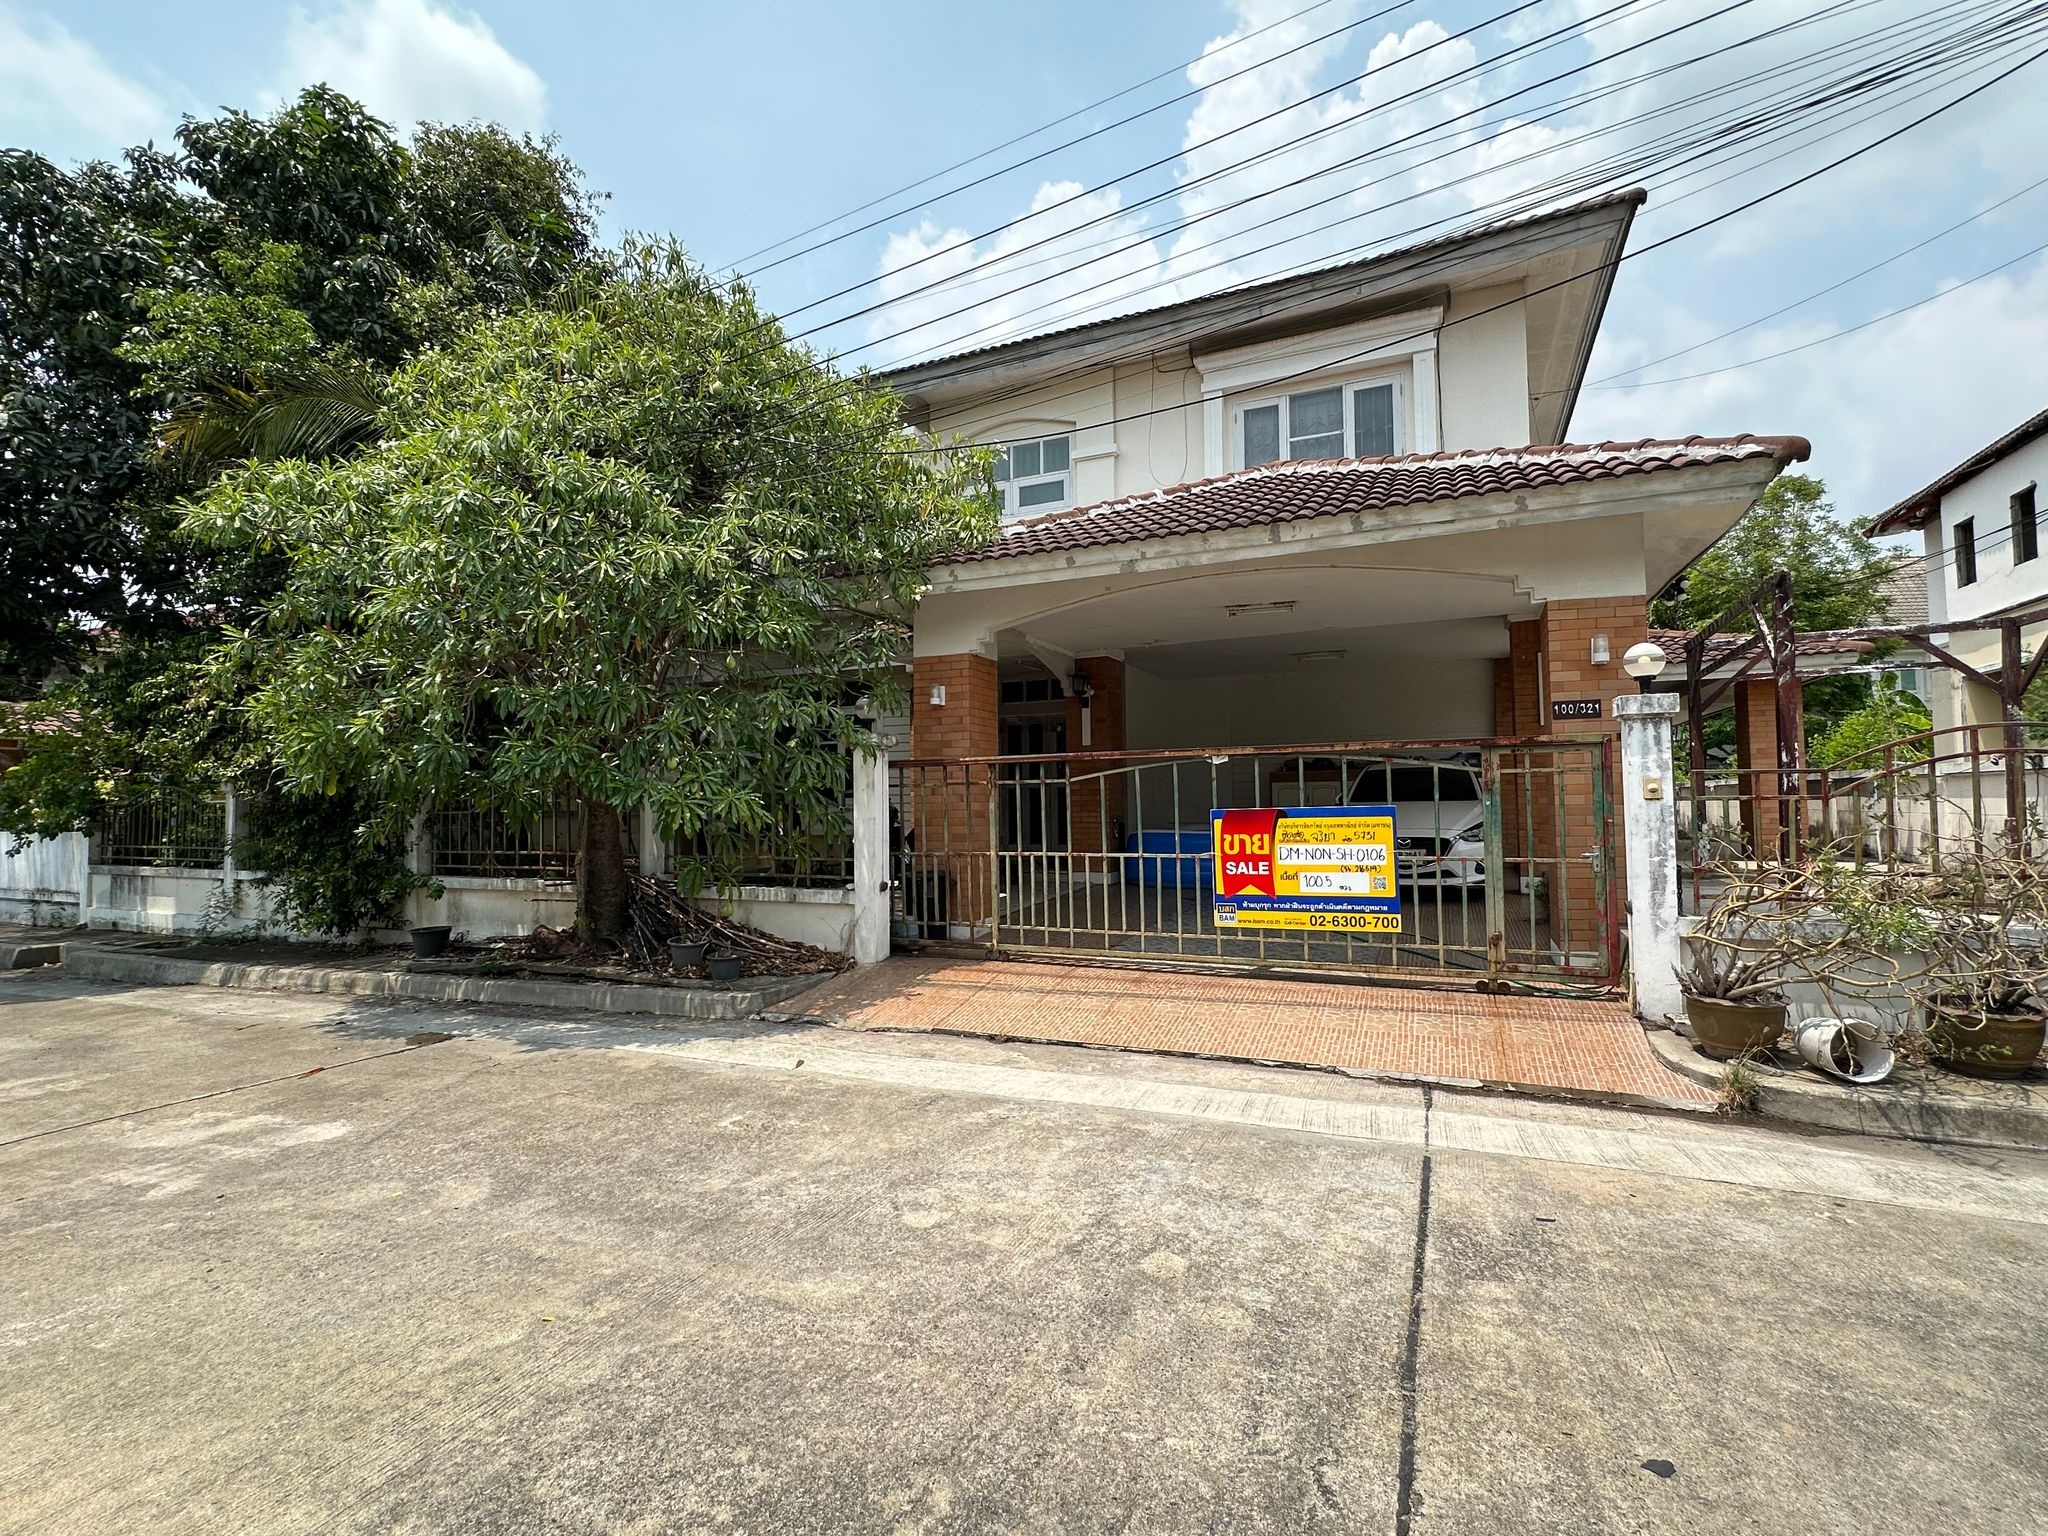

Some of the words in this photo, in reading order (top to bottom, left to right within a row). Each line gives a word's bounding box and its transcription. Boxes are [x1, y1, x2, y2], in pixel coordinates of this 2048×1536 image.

[1553, 703, 1600, 715] 100/321
[1223, 833, 1270, 855] ขาย
[1225, 861, 1270, 875] SALE
[1218, 905, 1235, 913] บสก
[1218, 914, 1235, 922] BAM
[1309, 914, 1399, 929] 02-6300-700
